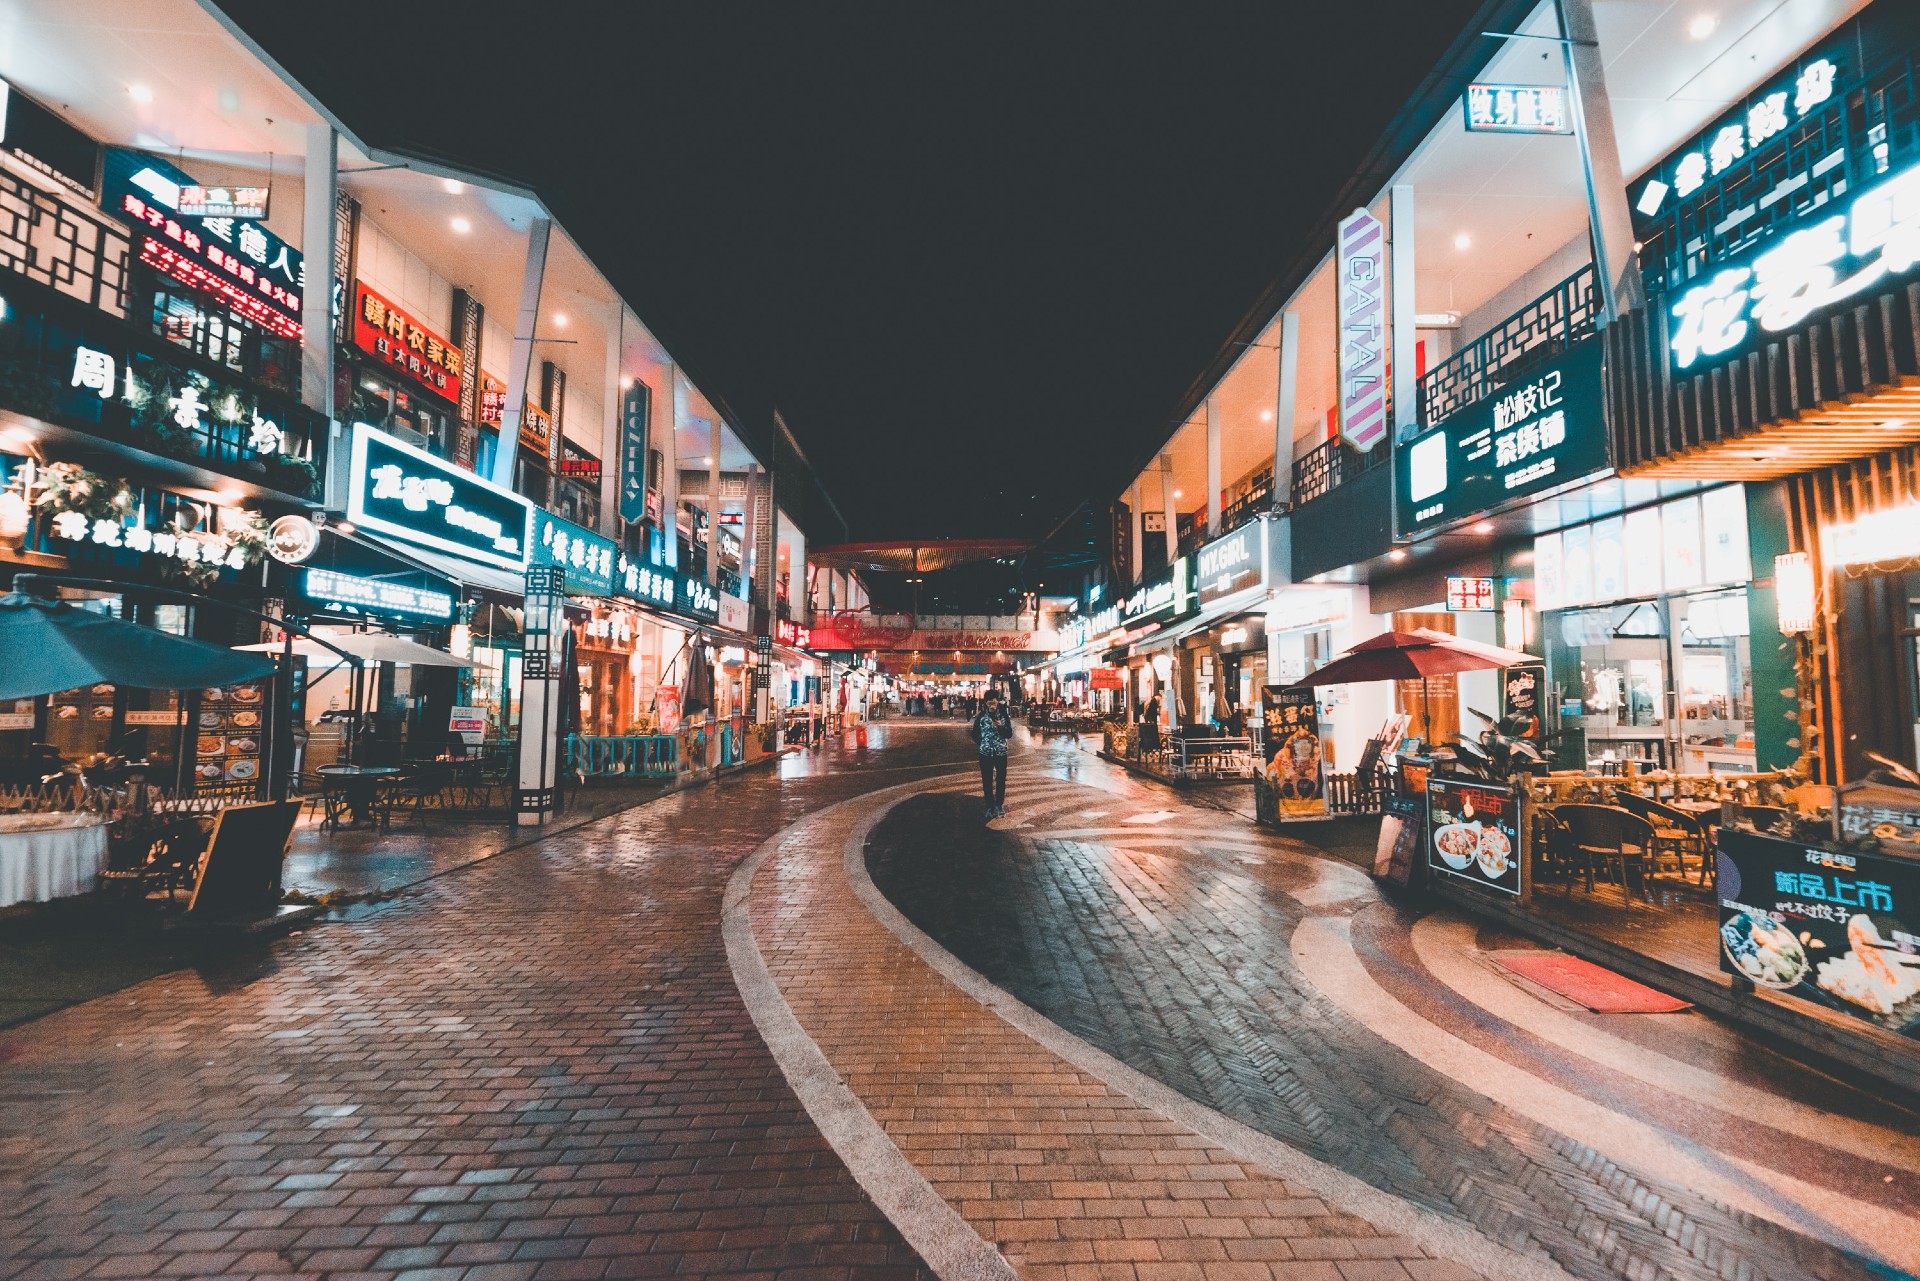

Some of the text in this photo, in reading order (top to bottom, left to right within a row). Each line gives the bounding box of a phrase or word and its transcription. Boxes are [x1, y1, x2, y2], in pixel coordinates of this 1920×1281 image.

[363, 294, 460, 377] 赣村农家菜
[1349, 256, 1377, 399] CATAL
[377, 337, 447, 389] 红太阳火锅
[1493, 370, 1563, 432] 松枝记
[1775, 871, 1893, 912] 新品上市
